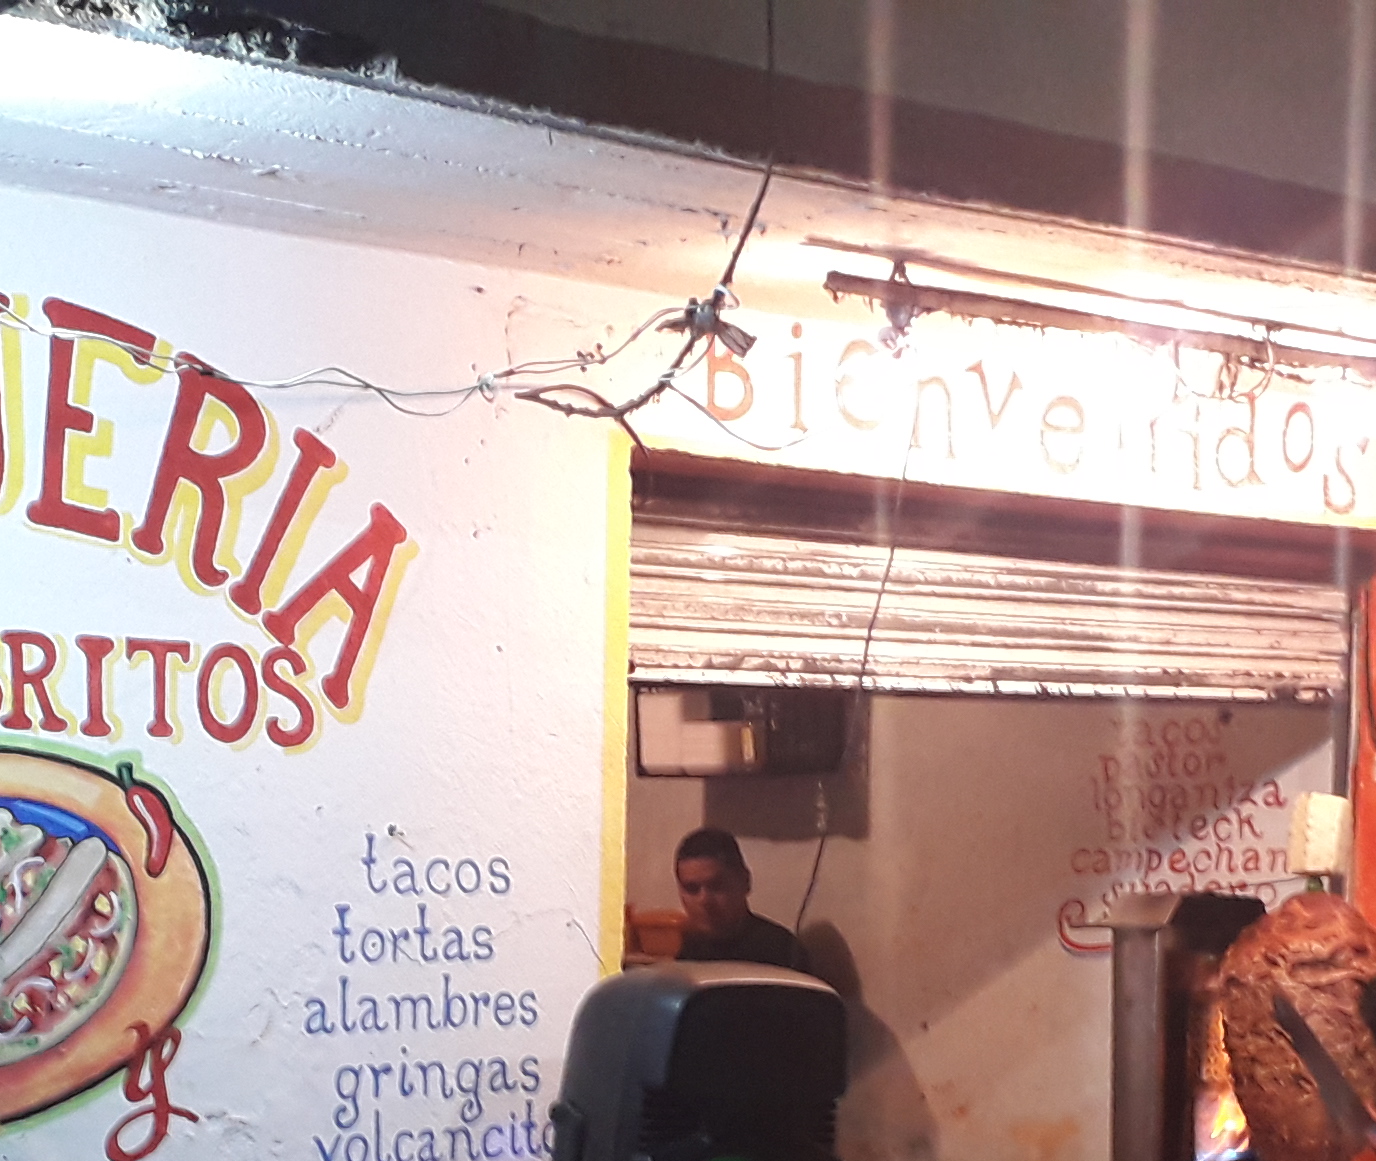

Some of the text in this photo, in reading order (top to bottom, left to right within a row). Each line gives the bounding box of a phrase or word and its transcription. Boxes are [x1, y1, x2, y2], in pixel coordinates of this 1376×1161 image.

[361, 831, 511, 896] tacos
[1071, 842, 1291, 879] campechan
[331, 901, 496, 965] tortas
[303, 972, 540, 1036] alambres
[332, 1046, 542, 1130] gringas
